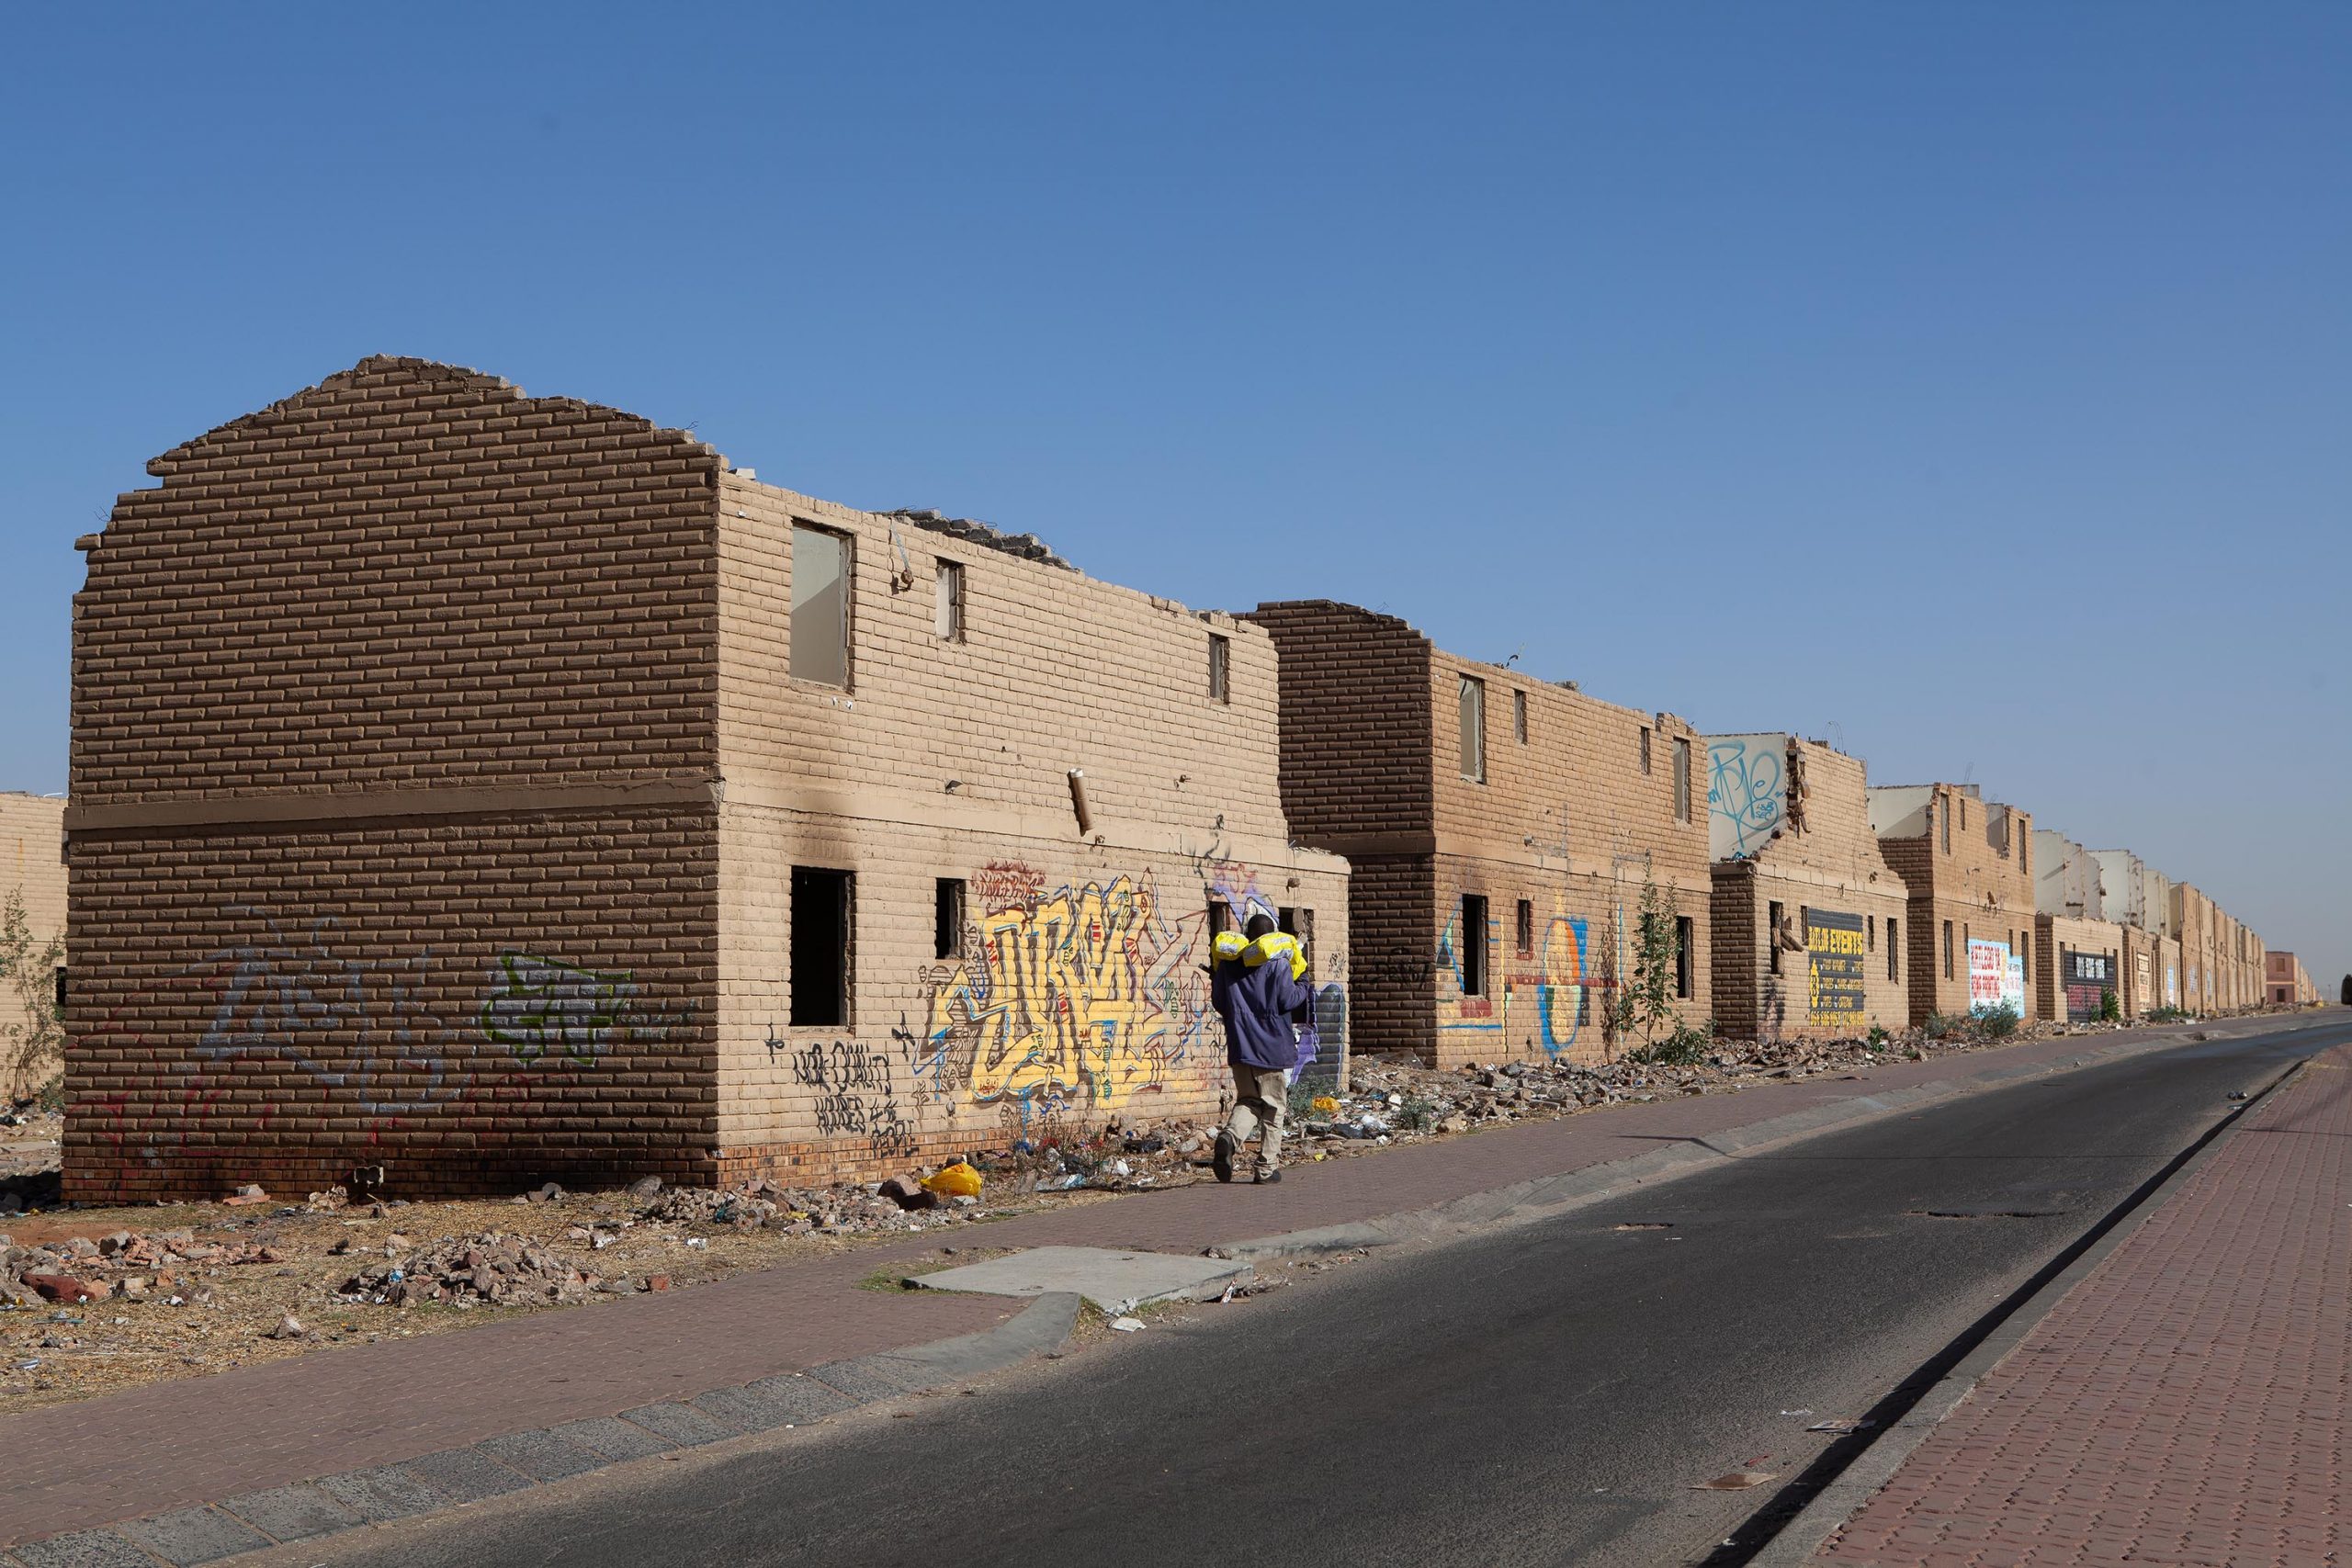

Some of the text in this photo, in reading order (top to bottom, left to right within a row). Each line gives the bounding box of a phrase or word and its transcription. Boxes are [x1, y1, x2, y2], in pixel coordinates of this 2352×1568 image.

[1830, 929, 1864, 955] EVENTS
[831, 1041, 891, 1097] QUALITY
[814, 1097, 866, 1136] HOUSES
